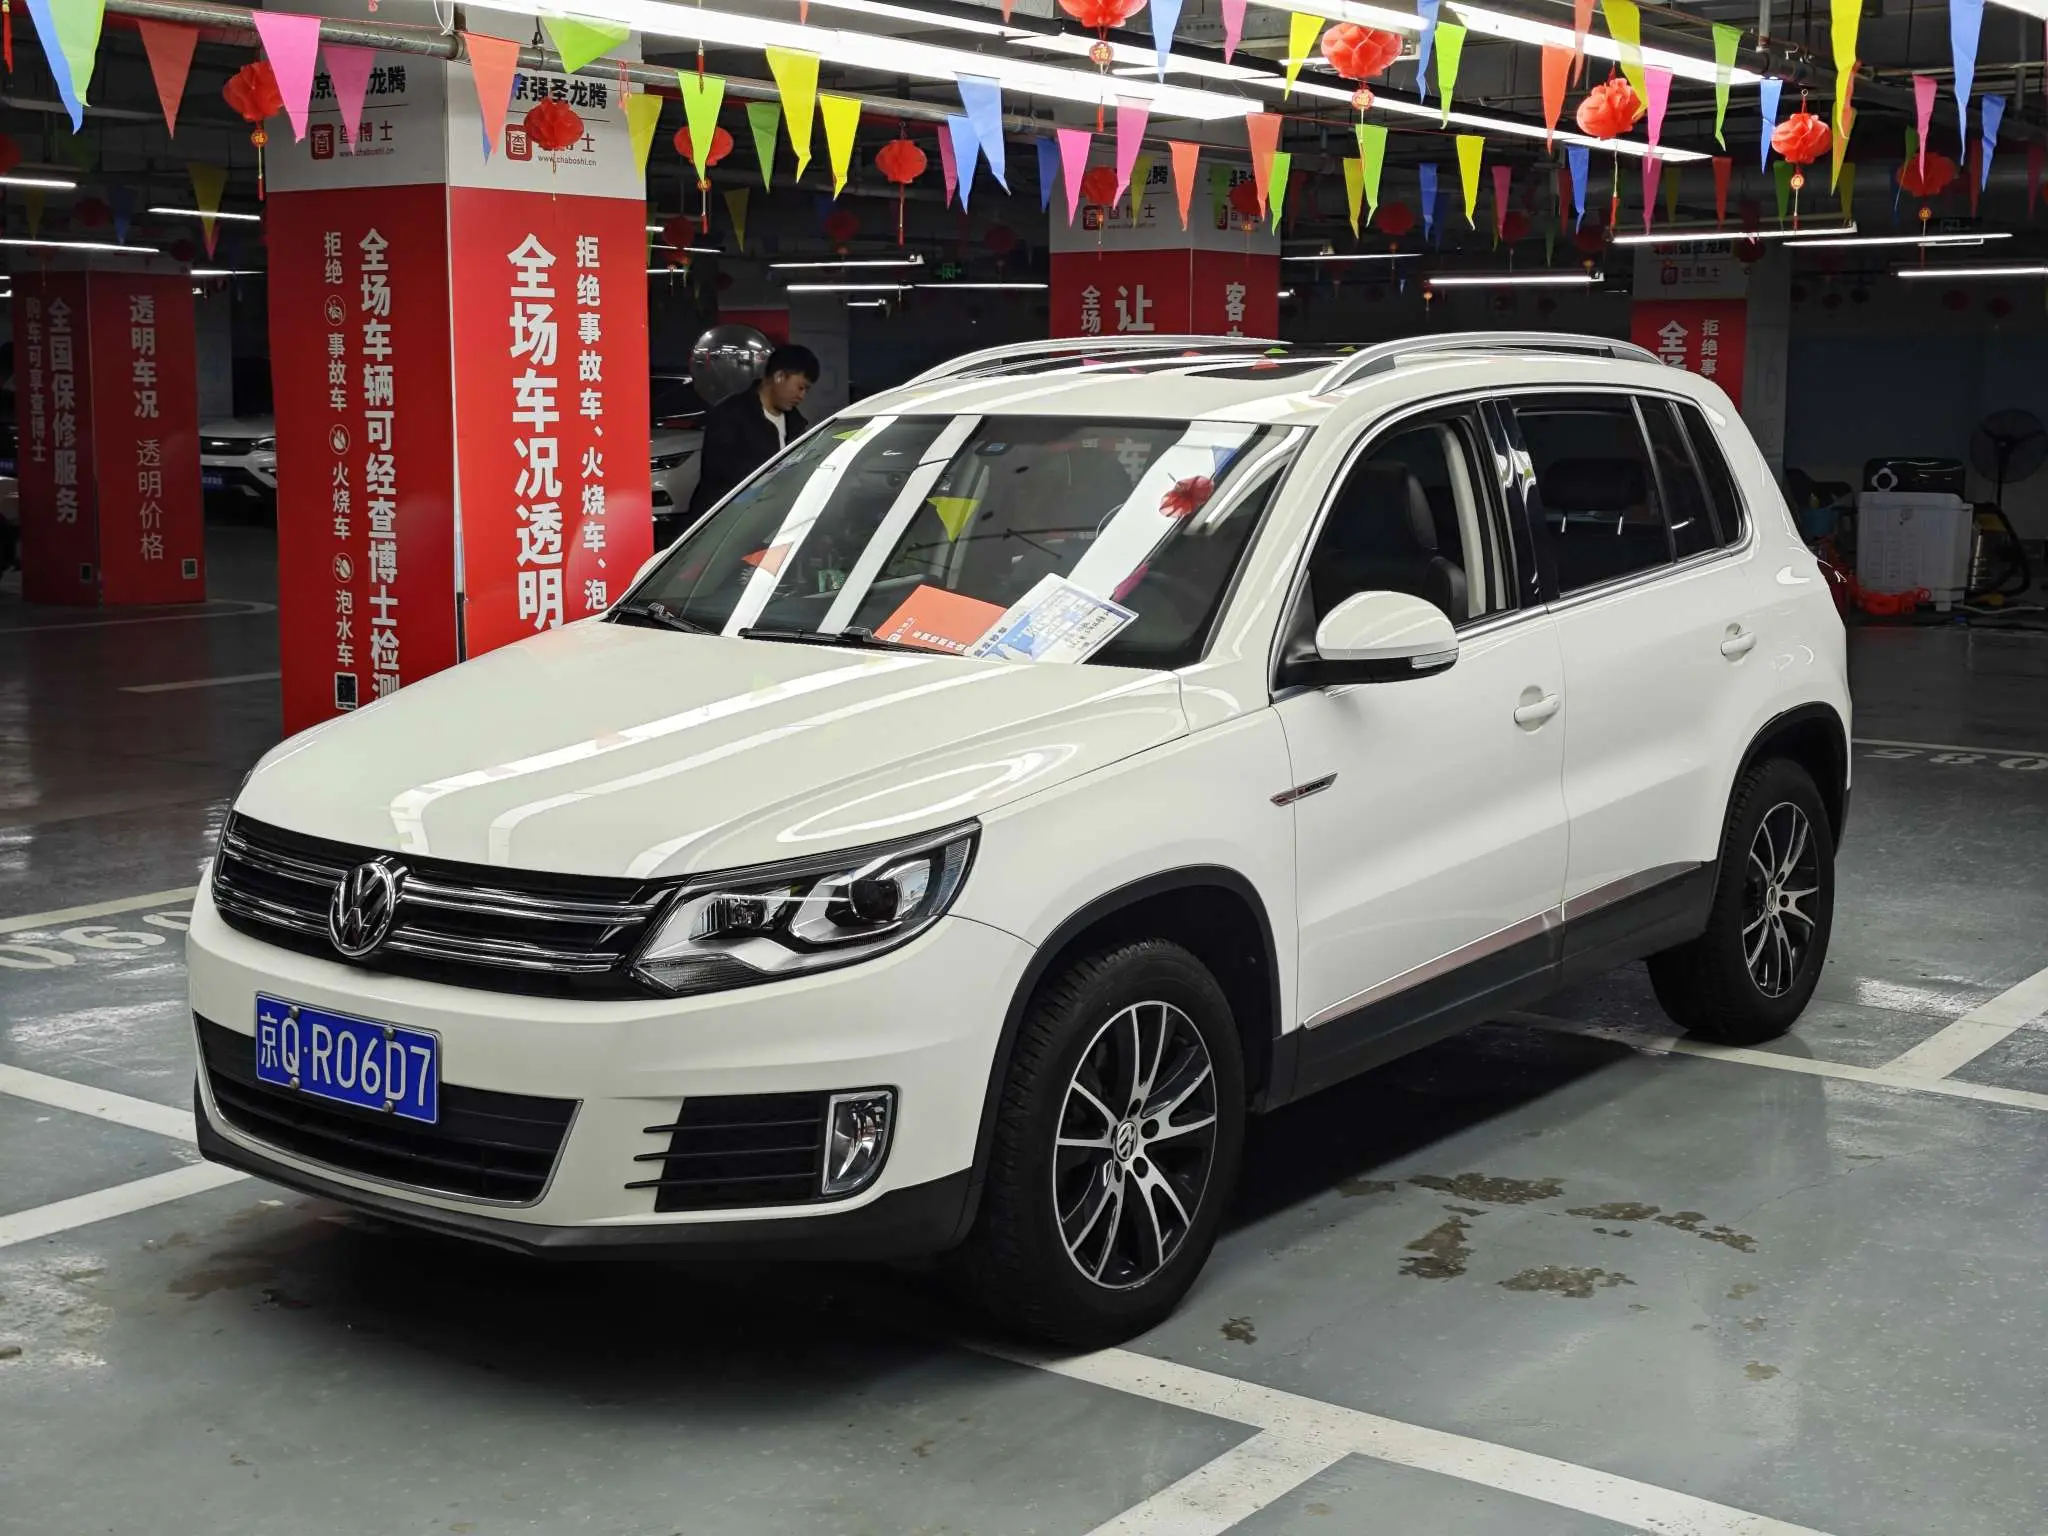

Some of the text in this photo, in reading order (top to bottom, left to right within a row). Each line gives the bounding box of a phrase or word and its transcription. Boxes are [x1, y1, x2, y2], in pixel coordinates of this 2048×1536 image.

[48, 297, 78, 524] 全国保修服务
[1115, 284, 1154, 332] 让
[1225, 282, 1246, 336] 客
[129, 295, 165, 561] 透明车况 透明价格
[323, 231, 355, 667] 拒绝 事故车 火烧车 泡水车
[507, 233, 564, 631] 全场车况透明
[260, 1011, 432, 1107] 京Q·R06D7
